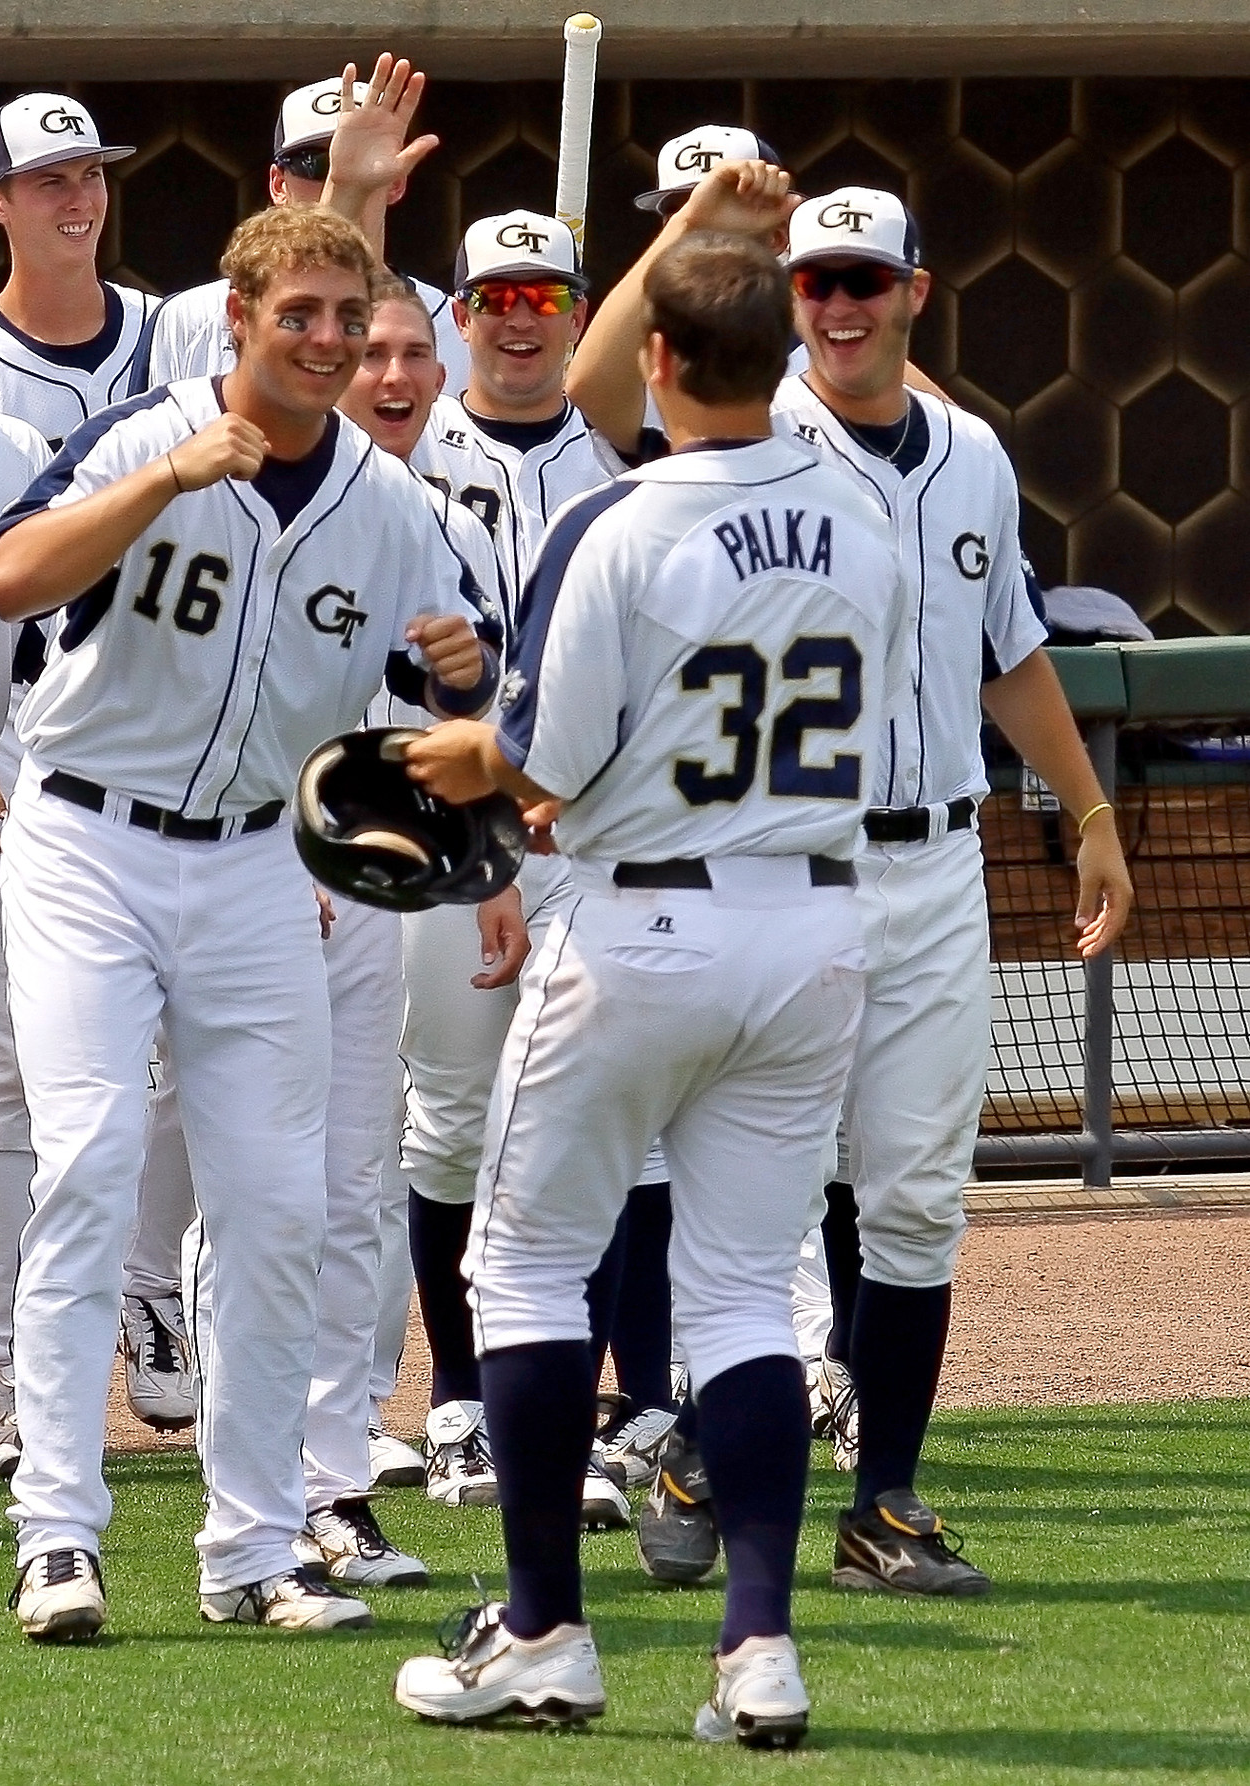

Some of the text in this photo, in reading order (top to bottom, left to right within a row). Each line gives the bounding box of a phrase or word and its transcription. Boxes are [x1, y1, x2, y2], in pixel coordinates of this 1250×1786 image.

[40, 106, 85, 135] GT
[675, 142, 723, 173] GT
[496, 222, 550, 253] GT
[817, 200, 873, 233] GT
[713, 507, 833, 582] PALKA
[132, 538, 234, 638] 16
[305, 583, 369, 649] GT
[672, 633, 865, 807] 32
